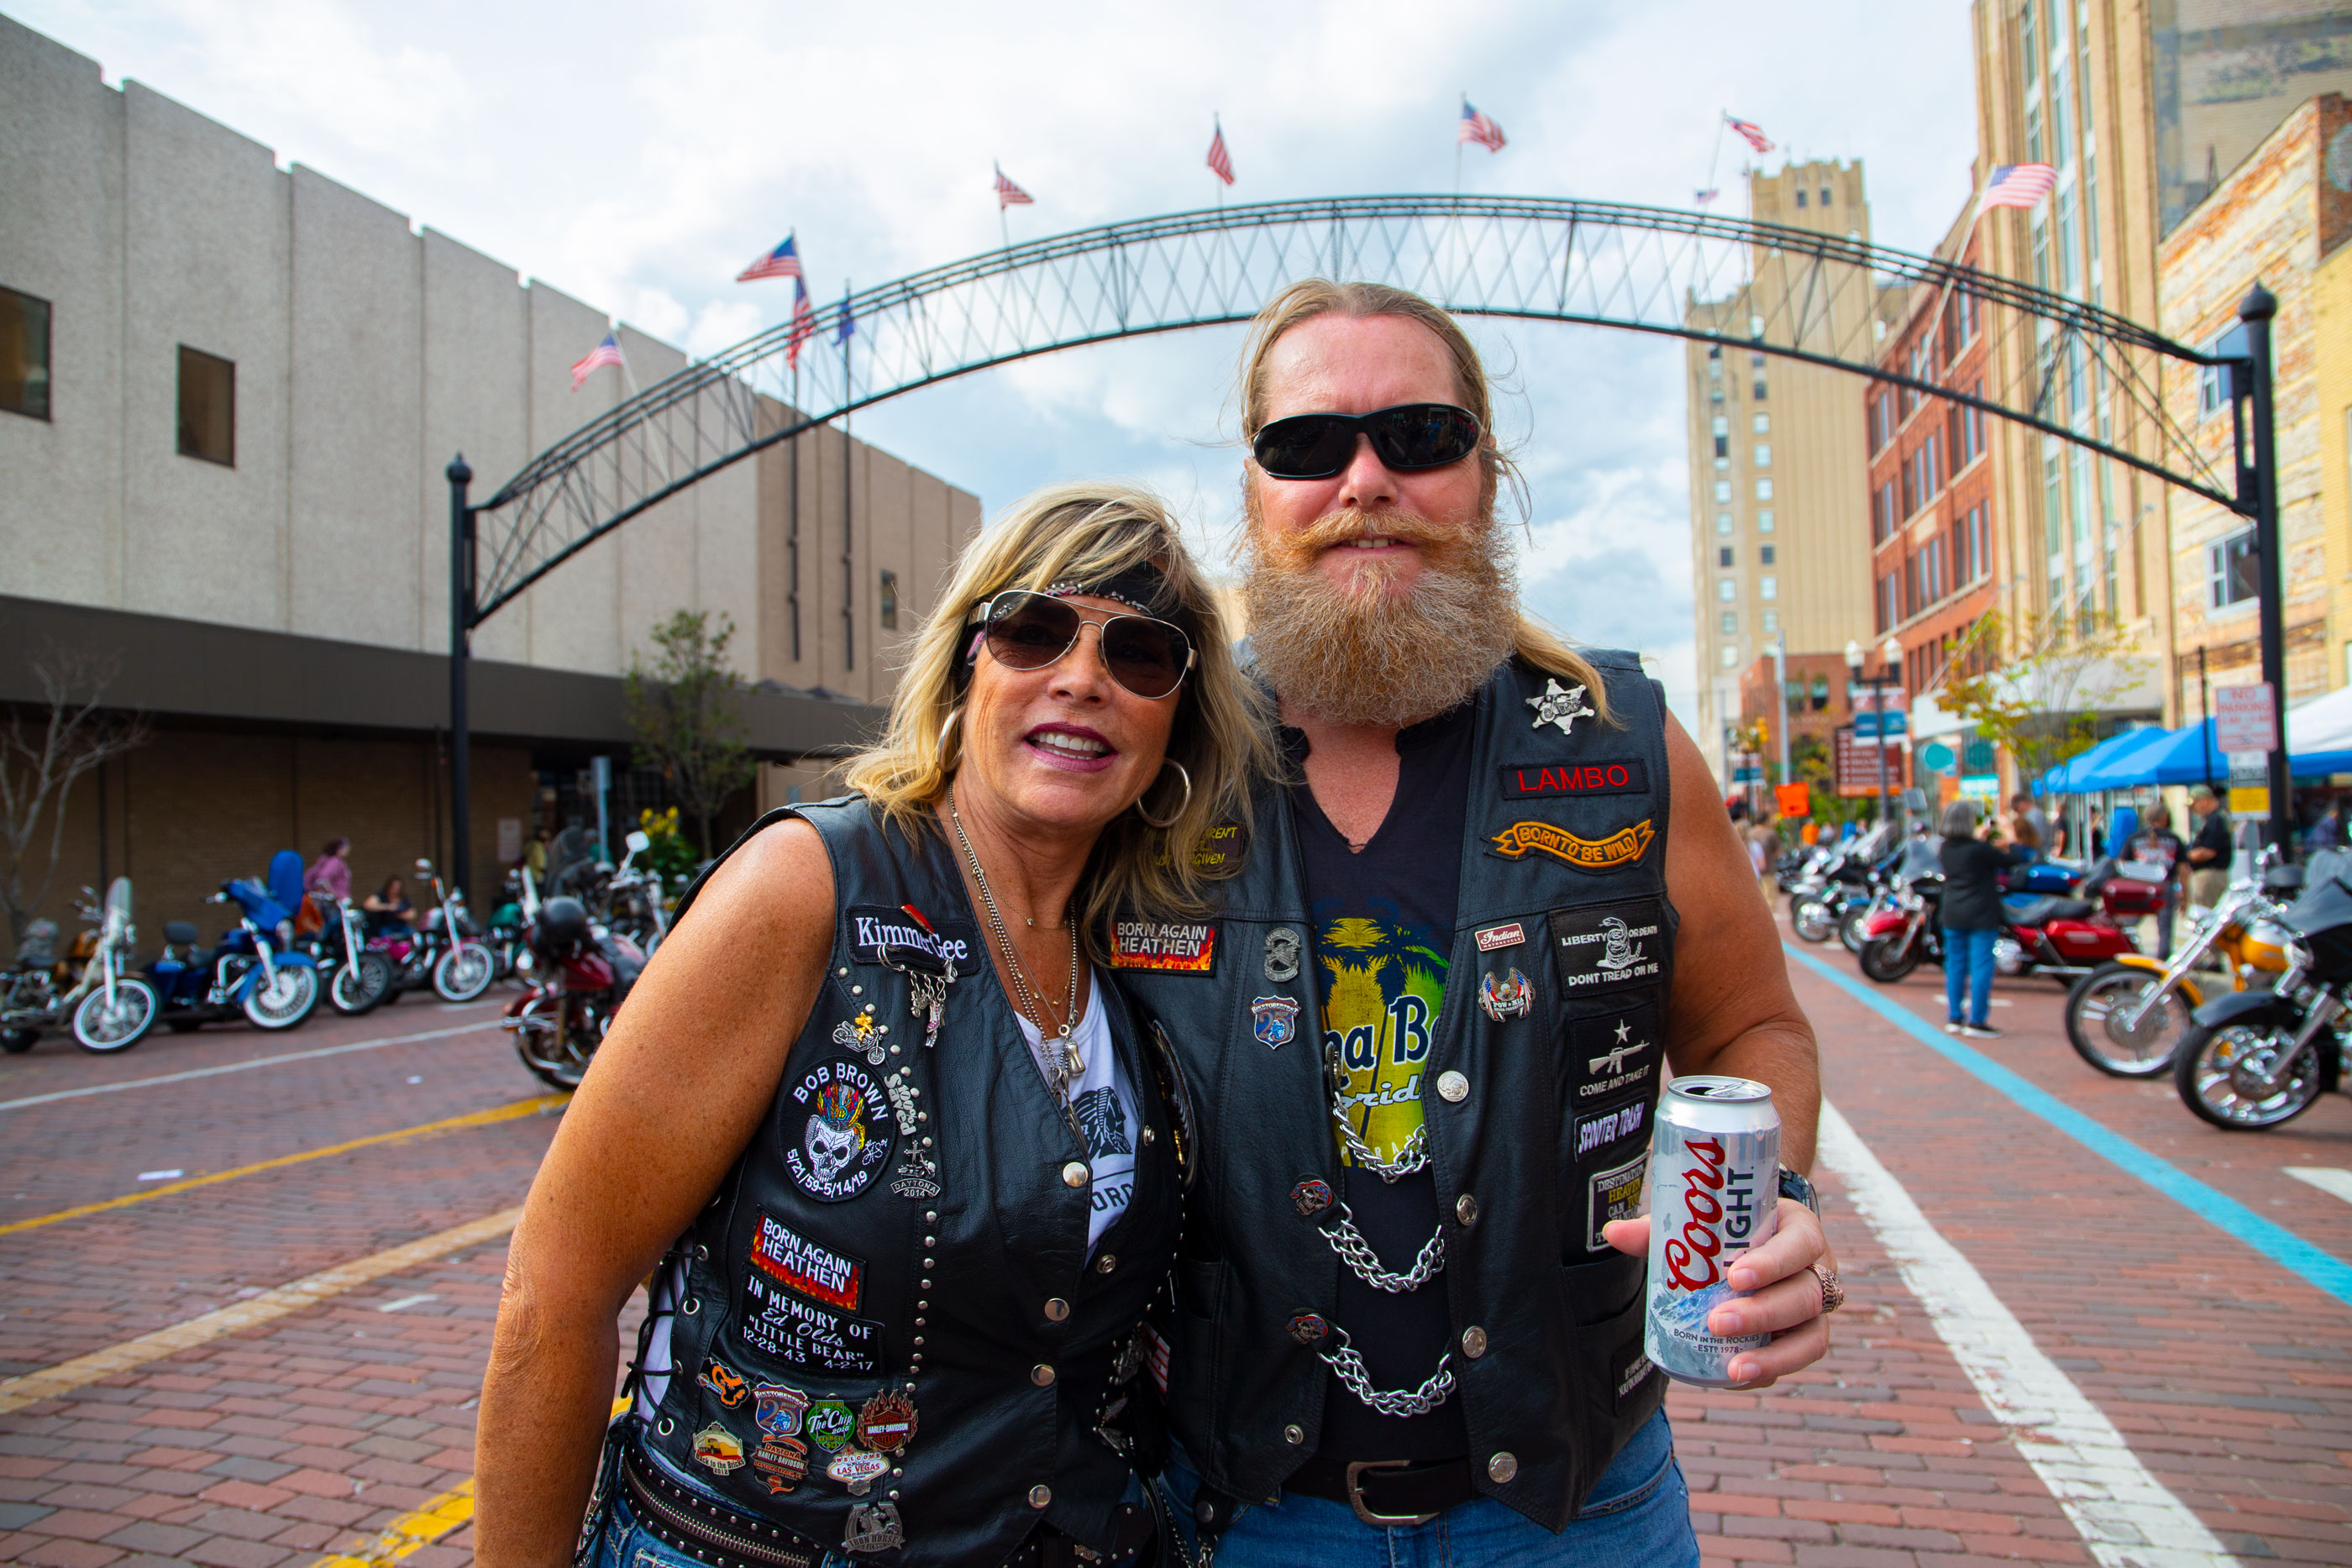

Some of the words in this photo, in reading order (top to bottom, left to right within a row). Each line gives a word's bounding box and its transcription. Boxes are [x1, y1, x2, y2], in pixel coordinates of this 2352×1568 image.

[1517, 765, 1630, 792] LAMBO
[1520, 827, 1561, 849] BORN
[1560, 836, 1579, 857] TO
[1581, 846, 1604, 861] BE
[1604, 836, 1635, 860] WILD
[1117, 922, 1156, 937] BORN
[1158, 924, 1207, 941] AGAIN
[1481, 931, 1520, 945] Indian
[1483, 937, 1521, 948] MOTORCYCLE
[1562, 932, 1608, 947] LIBERTY
[1629, 928, 1640, 938] OR
[1640, 926, 1657, 937] DEATH
[1119, 936, 1200, 957] HEATHEN
[1568, 973, 1600, 987] DONT
[1602, 968, 1632, 983] TREAD
[1634, 965, 1646, 977] ON
[1647, 962, 1659, 974] ME
[1258, 1011, 1291, 1042] 25
[793, 1066, 830, 1104] BOB
[836, 1062, 888, 1121] BROWN
[1579, 1080, 1608, 1097] COME
[1608, 1076, 1625, 1091] AND
[1625, 1067, 1644, 1084] TAKE
[1642, 1064, 1651, 1078] IT
[884, 1073, 916, 1135] Saved
[1578, 1113, 1619, 1154] SCOOTER
[1618, 1102, 1645, 1137] TRASH
[894, 1180, 937, 1193] DAYTONA
[904, 1188, 925, 1198] 2014
[1608, 1202, 1625, 1218] CAN
[1665, 1137, 1725, 1293] Coors
[1724, 1167, 1754, 1267] IGHT
[763, 1217, 801, 1252] BORN
[802, 1243, 851, 1277] AGAIN
[762, 1236, 845, 1293] HEATHEN
[748, 1275, 764, 1298] IN
[769, 1290, 838, 1330] MEMORY
[849, 1324, 873, 1340] OF
[749, 1314, 805, 1350] "LITTLE
[812, 1342, 864, 1361] BEAR"
[762, 1307, 788, 1326] Ed
[796, 1322, 846, 1348] Olds
[1674, 1328, 1698, 1341] BORN
[1699, 1335, 1709, 1344] IN
[1726, 1333, 1760, 1344] ROCKIES
[743, 1326, 806, 1363] 12-28-43
[824, 1361, 874, 1371] 4-2-17
[759, 1399, 797, 1434] 25
[807, 1414, 827, 1434] The
[827, 1410, 853, 1429] Chip
[867, 1422, 909, 1434] HARLEY-DAVIDSON
[696, 1453, 709, 1463] Back
[727, 1459, 744, 1468] Bricks
[757, 1450, 805, 1470] HARLEY-DAVIDSON
[765, 1442, 801, 1460] DAYTONA
[837, 1453, 880, 1463] WELCOME
[837, 1466, 852, 1475] LAS
[855, 1463, 879, 1472] VEGAS
[849, 1535, 869, 1546] IRON
[871, 1534, 899, 1544] HORSE
